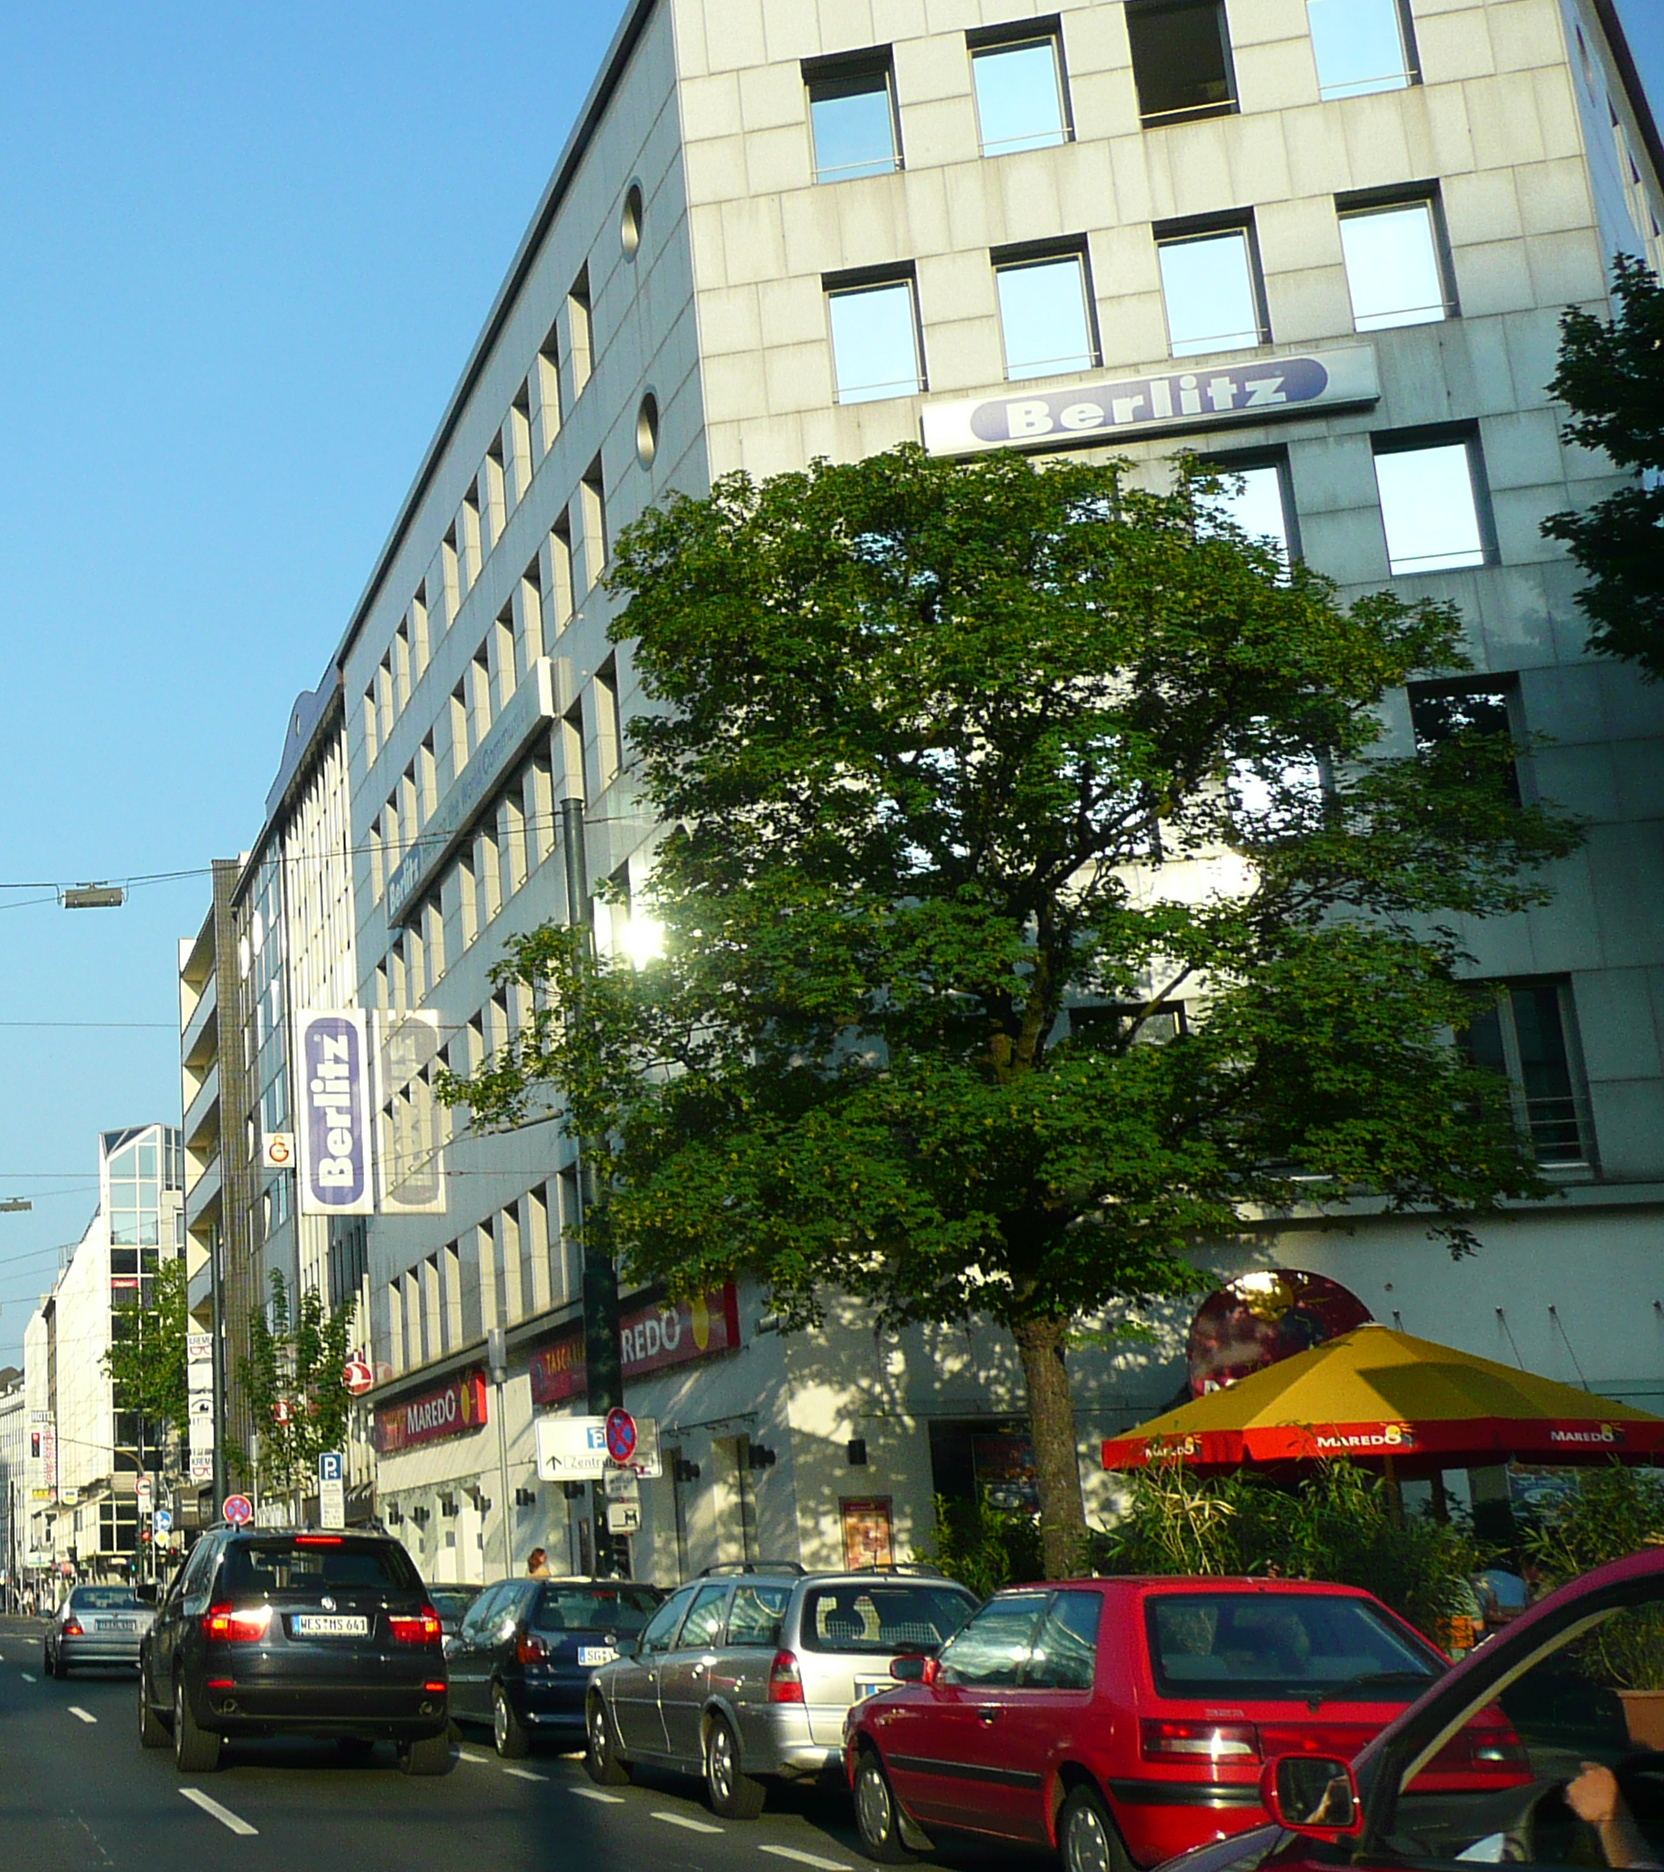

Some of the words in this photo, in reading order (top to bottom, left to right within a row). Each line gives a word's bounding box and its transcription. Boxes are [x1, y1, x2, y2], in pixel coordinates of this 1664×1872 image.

[1006, 375, 1287, 438] Berlitz
[310, 1034, 354, 1187] Berlitz
[620, 1306, 682, 1364] REDO
[407, 1388, 456, 1435] MAREDO
[1317, 1433, 1401, 1448] MAREDO
[1550, 1431, 1614, 1442] MAREDO
[324, 1457, 337, 1479] P
[300, 1618, 321, 1630] WES
[346, 1619, 365, 1631] 641
